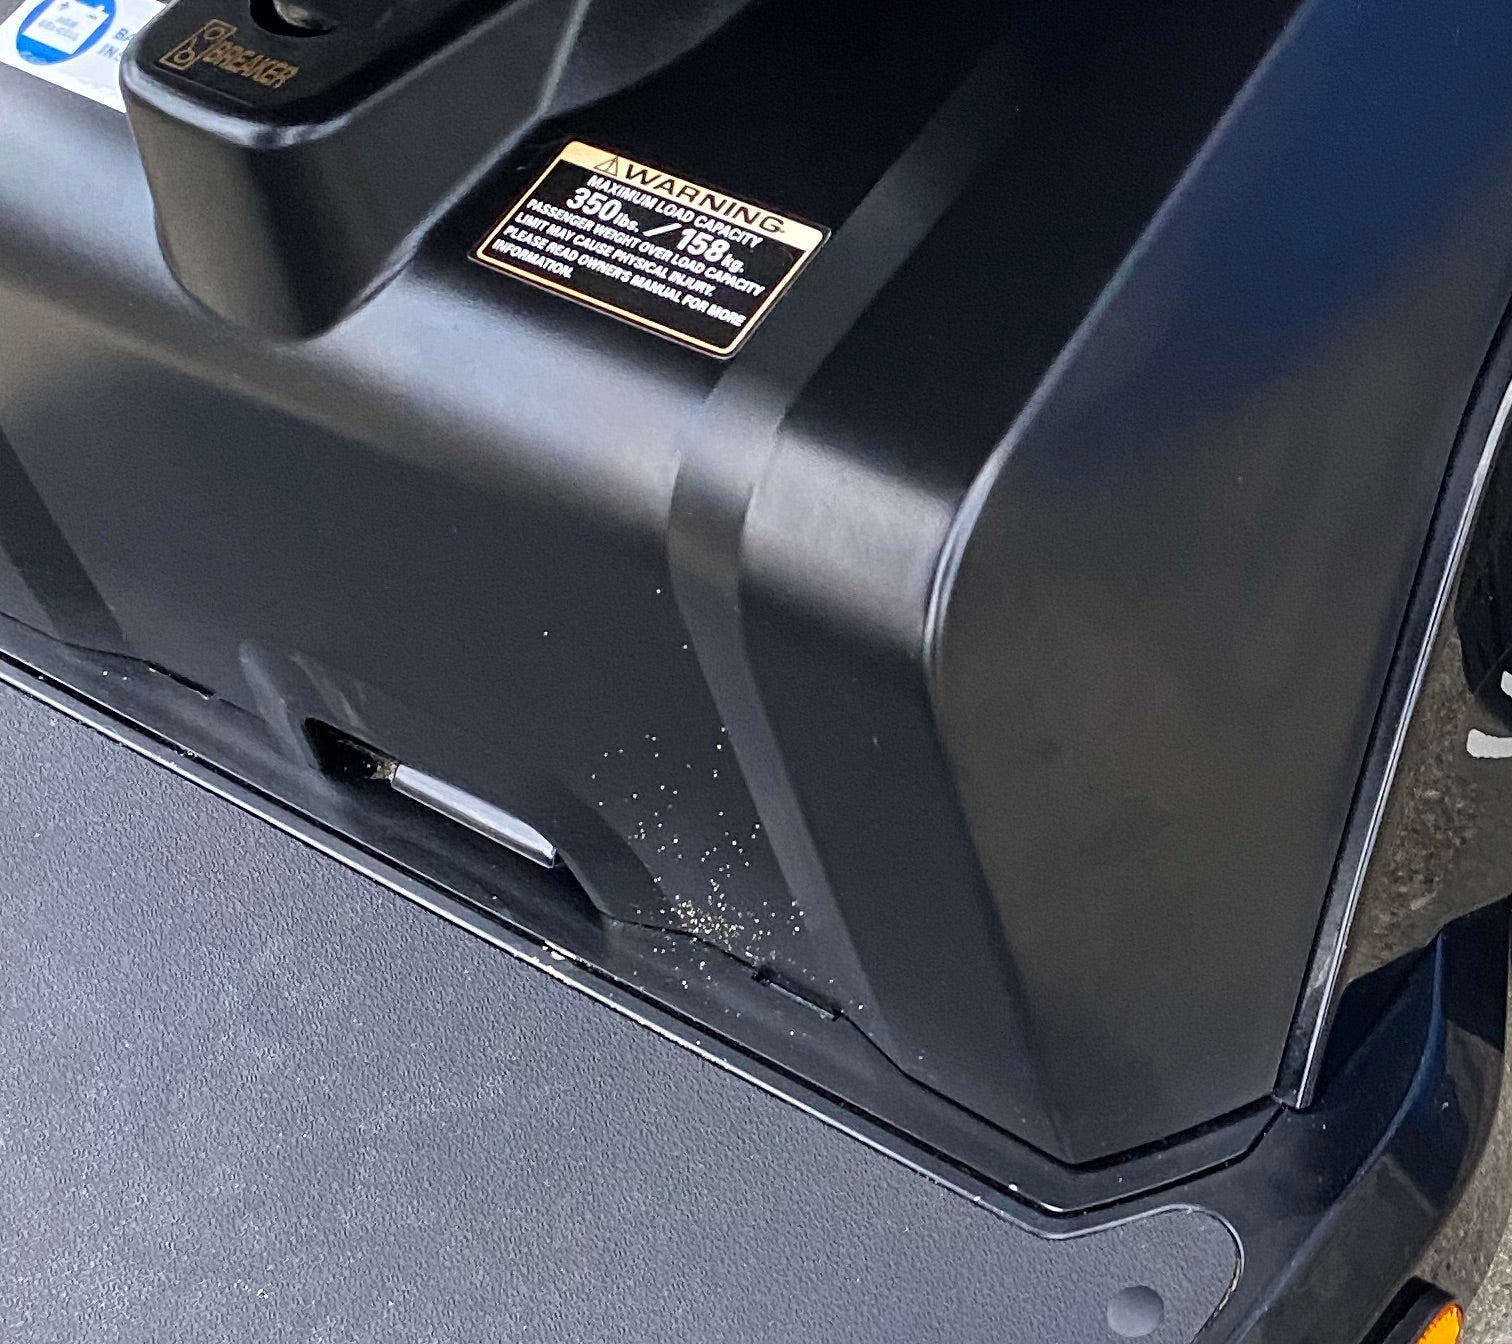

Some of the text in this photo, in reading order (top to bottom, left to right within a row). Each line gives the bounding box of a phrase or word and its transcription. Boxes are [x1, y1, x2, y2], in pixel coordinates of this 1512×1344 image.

[202, 40, 299, 88] BREAKER
[587, 175, 763, 248] MAXIMUM LOAD CAPACITY
[625, 164, 785, 233] WARNING
[503, 225, 549, 250] PLEASE
[545, 242, 579, 261] READ
[629, 274, 682, 303] MANUAL
[681, 294, 709, 313] FOR
[706, 304, 747, 327] MORE
[515, 212, 550, 231] LIMIT
[546, 223, 576, 242] MAY
[572, 234, 615, 257] CAUSE
[611, 249, 669, 279] PHYSICAL
[526, 198, 765, 296] PASSENGER WEIGHT OVER LOAD CAPACITY
